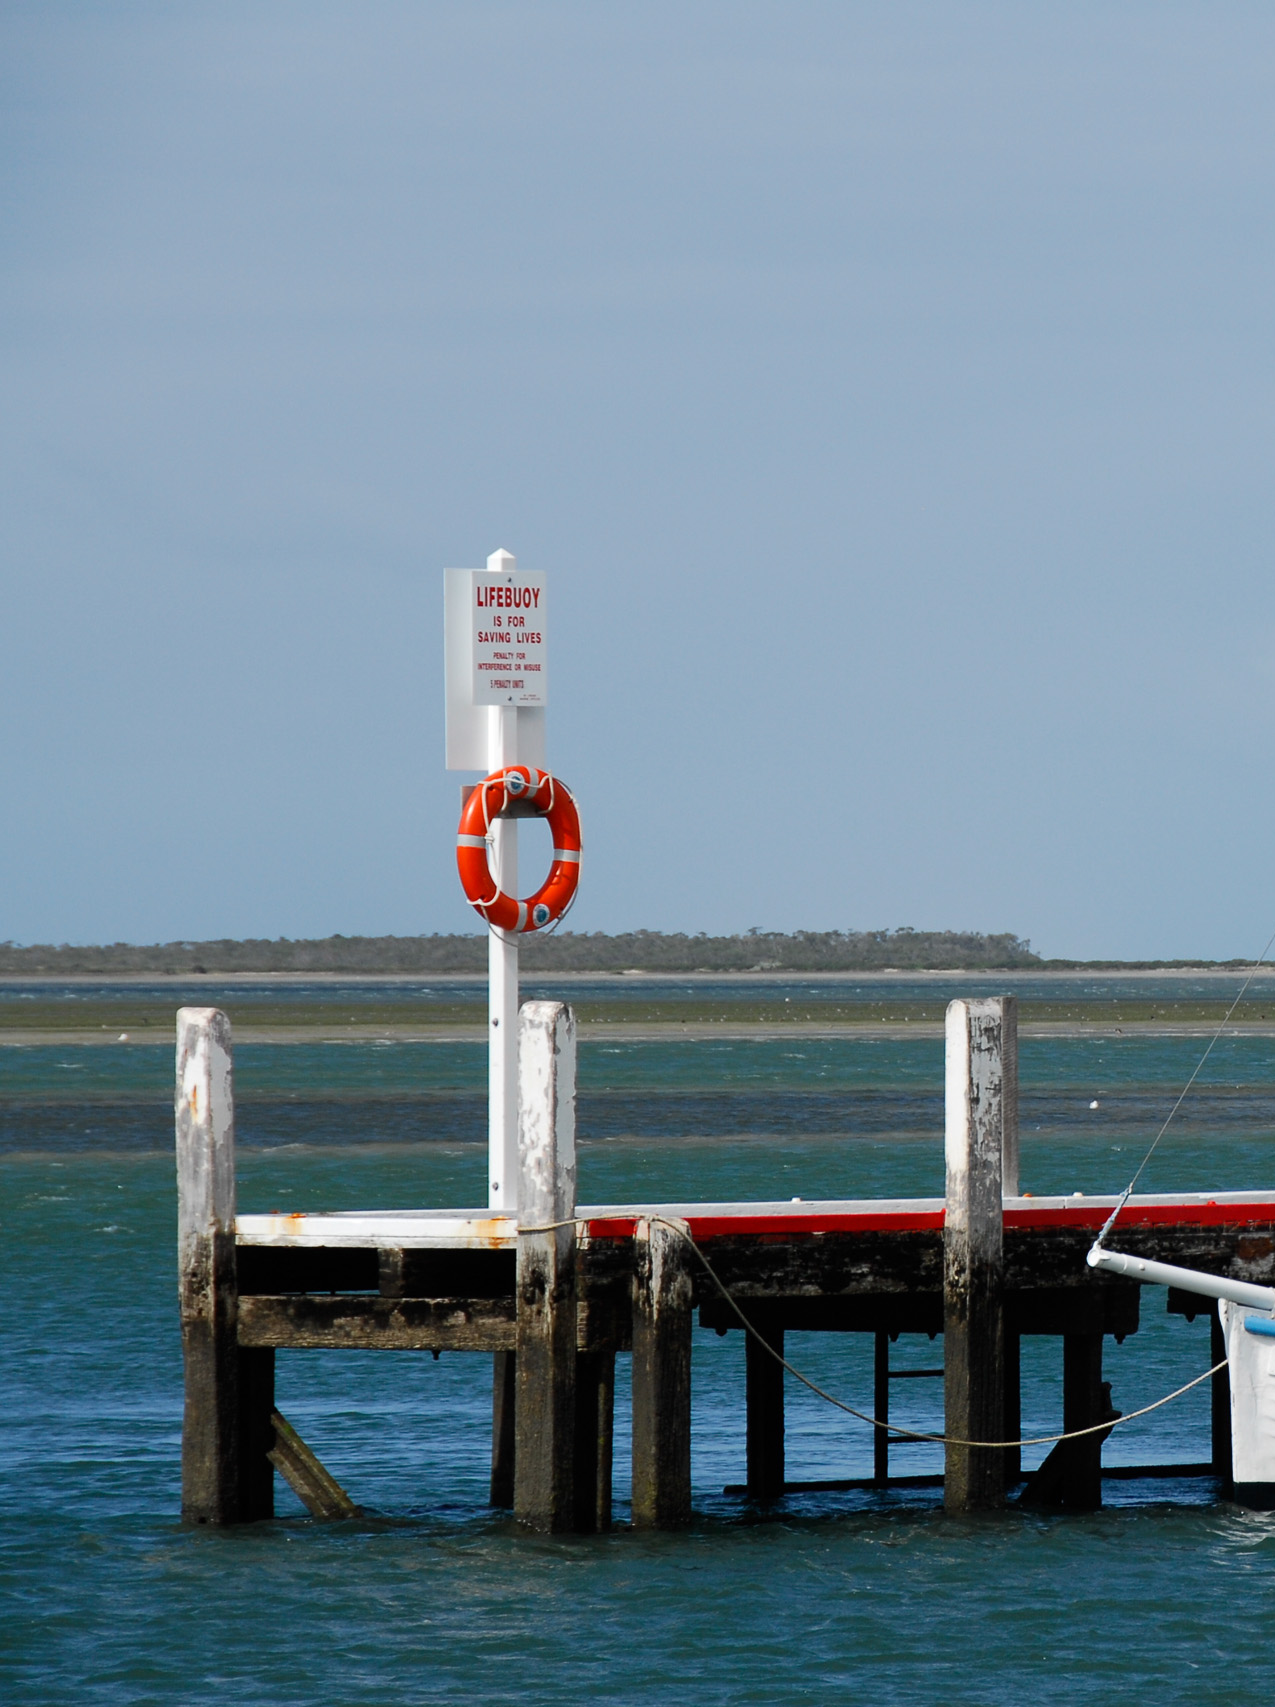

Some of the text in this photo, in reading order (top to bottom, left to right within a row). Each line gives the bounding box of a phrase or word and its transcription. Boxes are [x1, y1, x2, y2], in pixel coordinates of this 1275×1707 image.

[477, 586, 540, 608] LIFEBUOY
[493, 615, 525, 627] IS FOR
[478, 631, 542, 643] SAVING LIVES
[493, 652, 526, 660] PENALTY FOR
[478, 663, 512, 671] INTERFERENCE
[514, 663, 521, 671] OR
